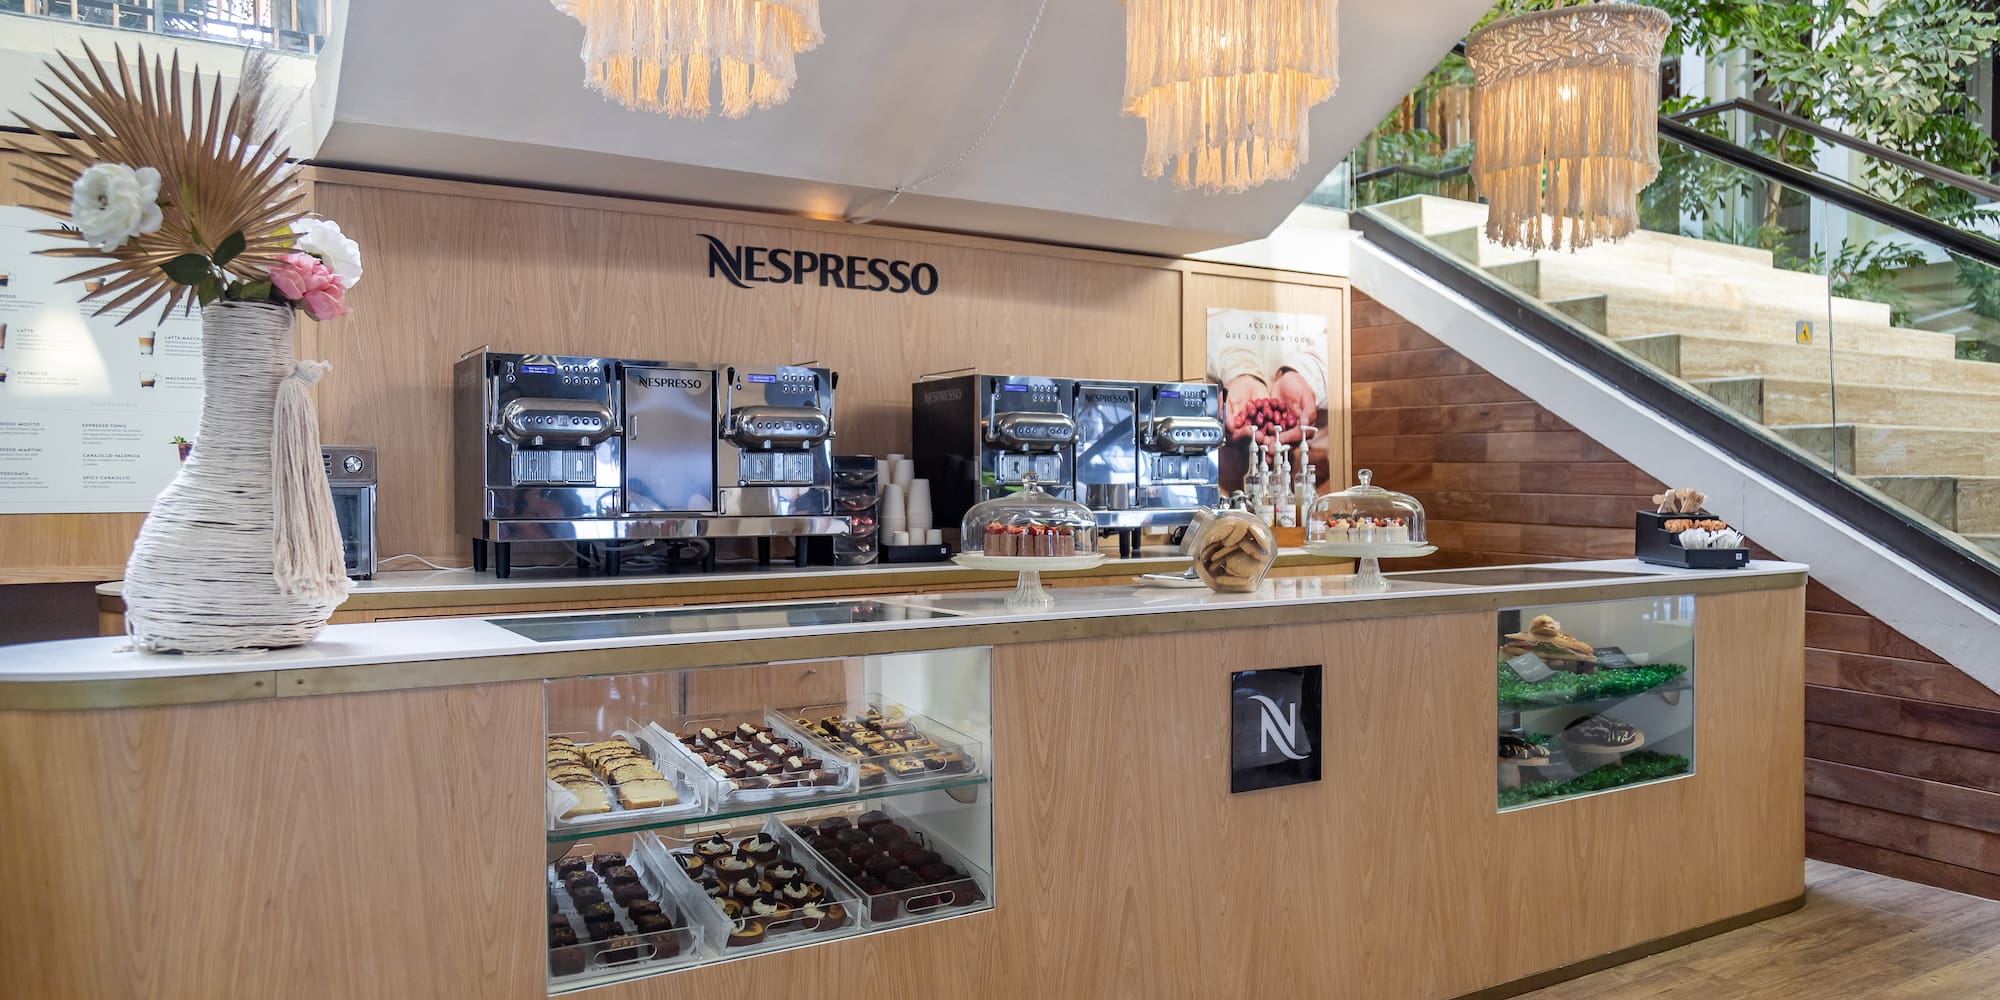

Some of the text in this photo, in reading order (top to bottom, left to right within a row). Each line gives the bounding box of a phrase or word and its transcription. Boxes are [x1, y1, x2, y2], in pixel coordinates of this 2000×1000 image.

[696, 234, 939, 296] NESPRESSO
[1225, 332, 1241, 340] QUE
[1246, 333, 1257, 341] LO
[1260, 334, 1286, 342] DICEN
[639, 375, 702, 389] NESPRESSO
[1085, 392, 1129, 404] NESPRESSO
[1247, 695, 1310, 760] N
